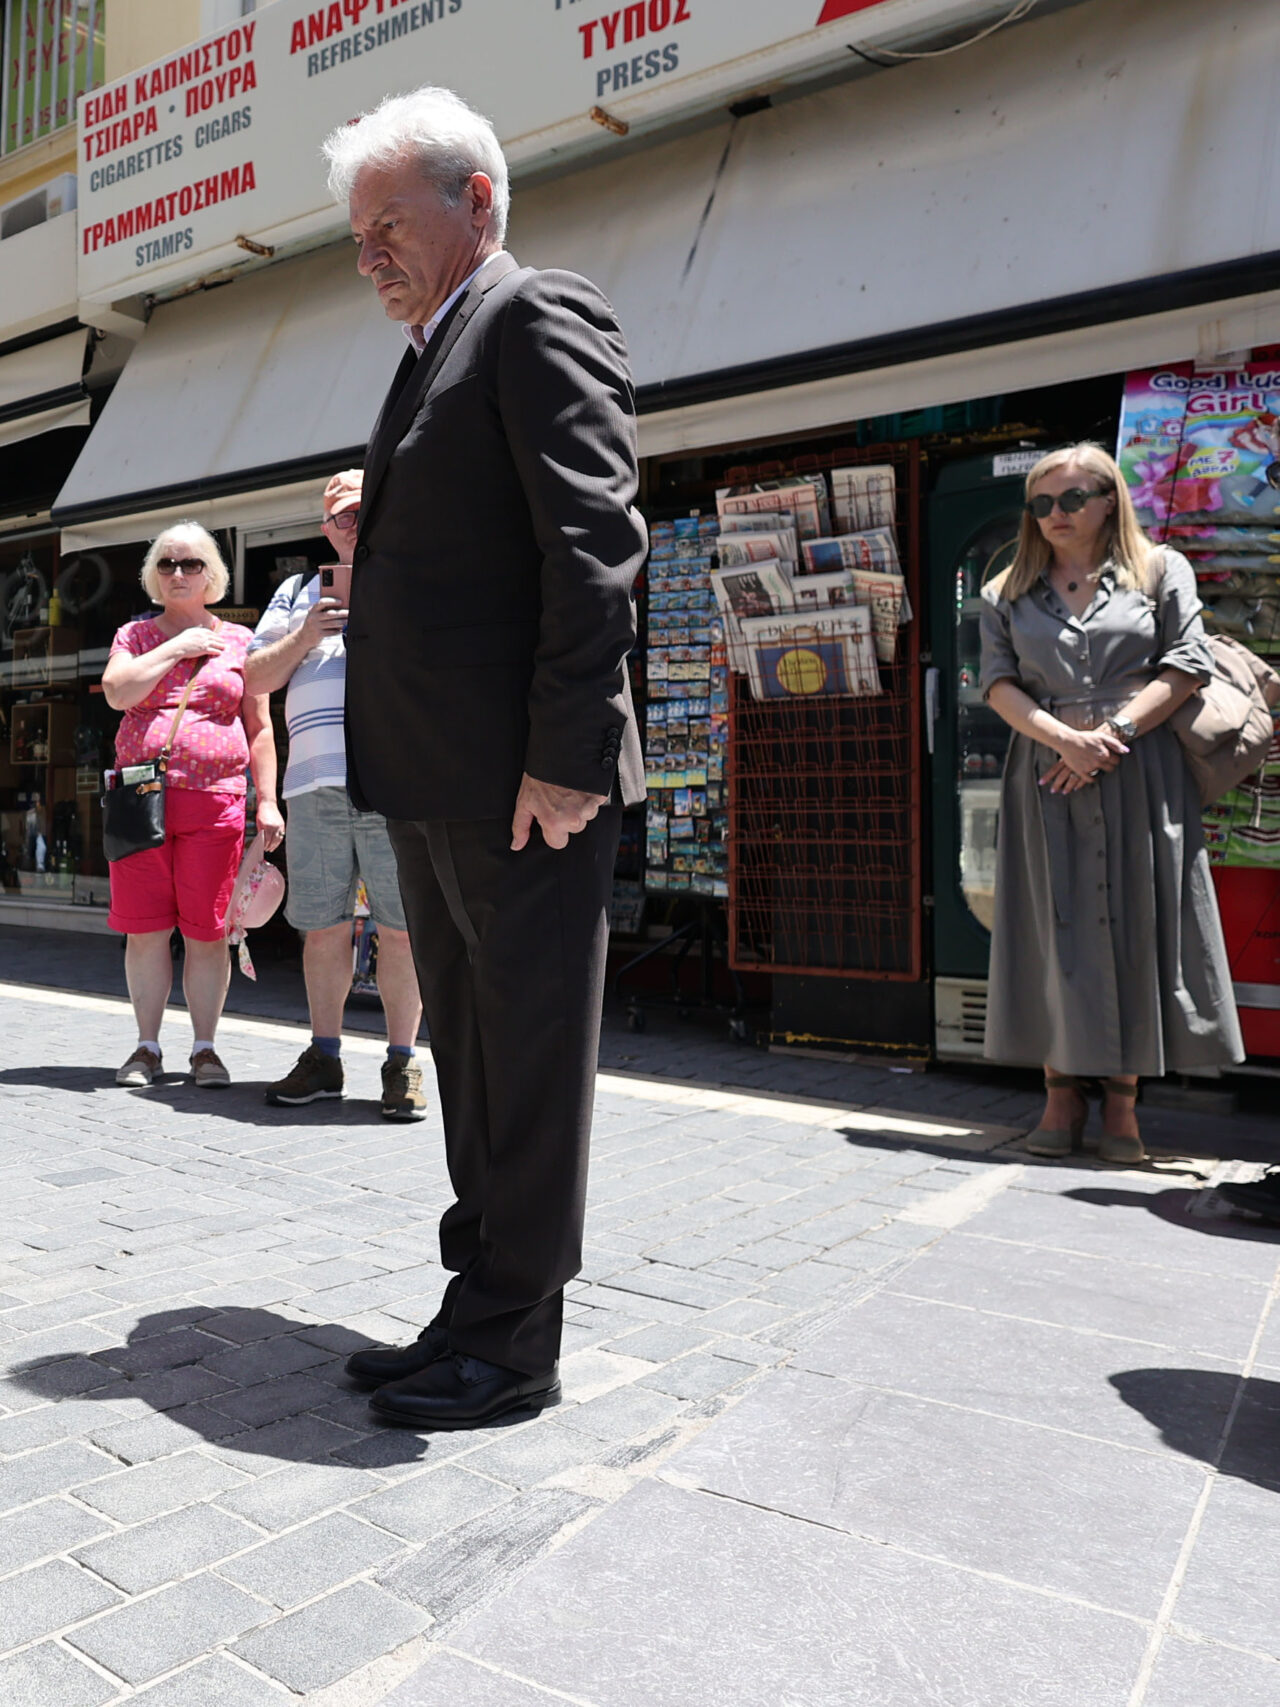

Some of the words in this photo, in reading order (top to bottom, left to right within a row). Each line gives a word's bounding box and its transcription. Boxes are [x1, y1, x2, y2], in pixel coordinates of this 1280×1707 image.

[290, 0, 412, 54] ΑΝΑΨ
[308, 0, 462, 78] REFRESHMENTS
[578, 0, 691, 60] ΤΥΠΟΣ
[84, 84, 127, 129] ΕΙΔΗ
[135, 20, 257, 105] ΚΑΠΝΙΣΤΟΥ
[597, 42, 679, 98] PRESS
[83, 105, 158, 162] ΤΣΙΓΑΡΑ
[185, 60, 257, 118] ΠΟΥΡΑ
[90, 134, 183, 192] CIGARETTES
[195, 105, 252, 149] CIGARS
[83, 160, 256, 255] ΓΡΑΜΜΑΤΟΣΗΜΑ
[135, 227, 193, 267] STAMPS
[1151, 373, 1223, 390] Good
[1187, 392, 1266, 414] Girl
